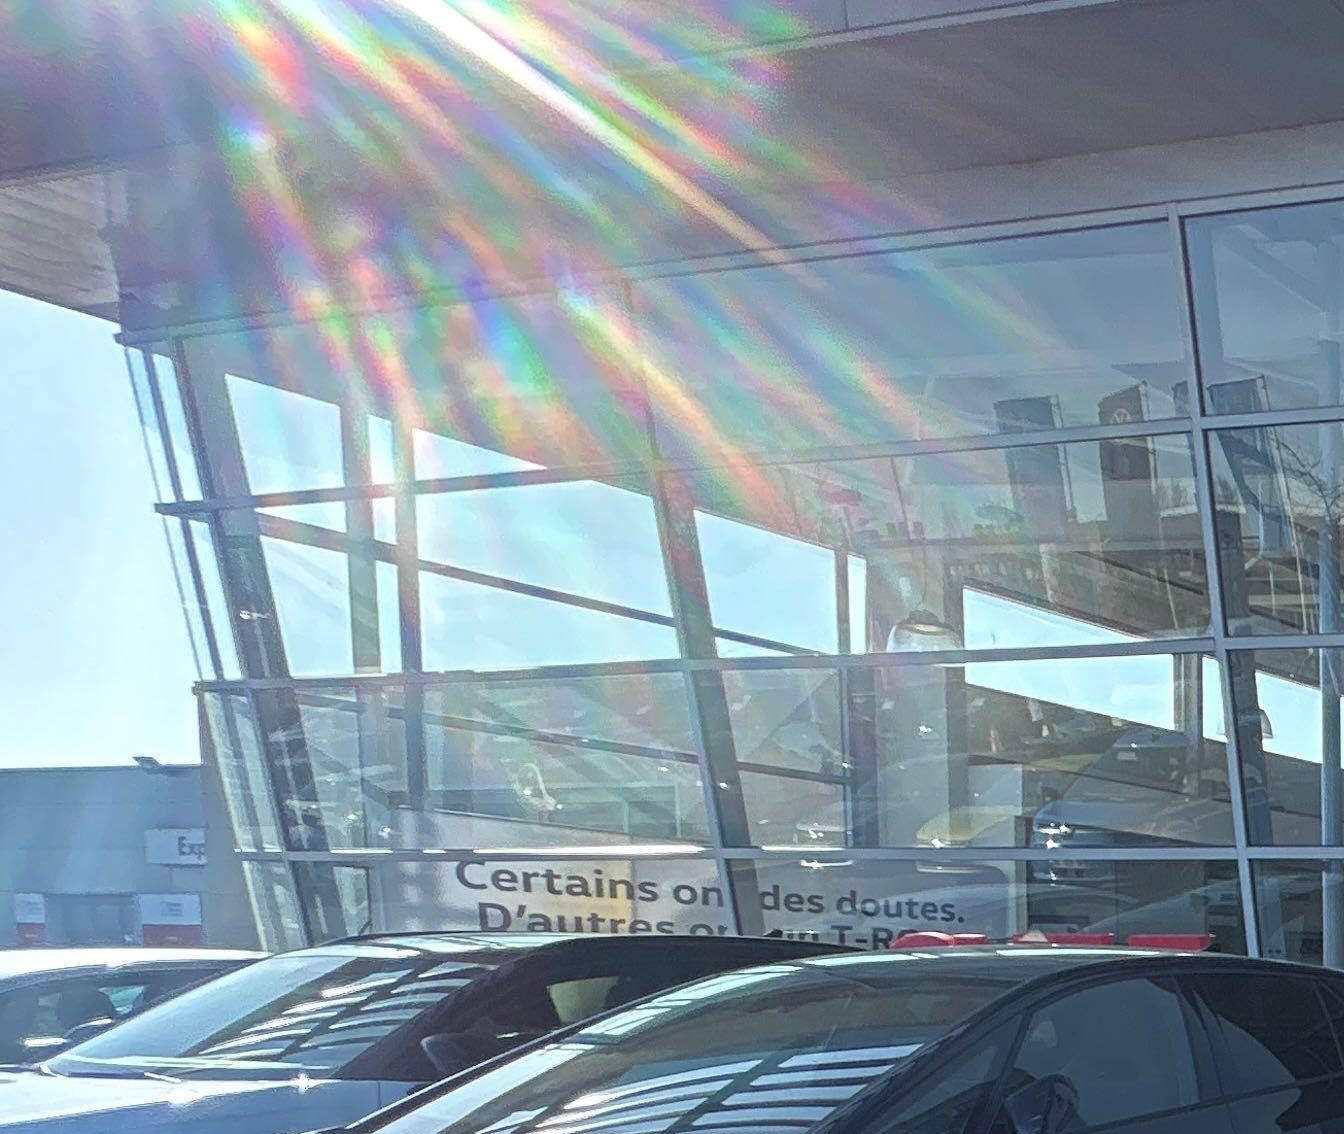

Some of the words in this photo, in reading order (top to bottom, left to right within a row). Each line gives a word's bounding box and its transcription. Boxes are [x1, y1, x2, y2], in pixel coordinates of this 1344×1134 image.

[456, 860, 659, 902] Certains
[672, 884, 725, 907] on
[759, 885, 824, 914] des
[836, 890, 965, 923] doutes.
